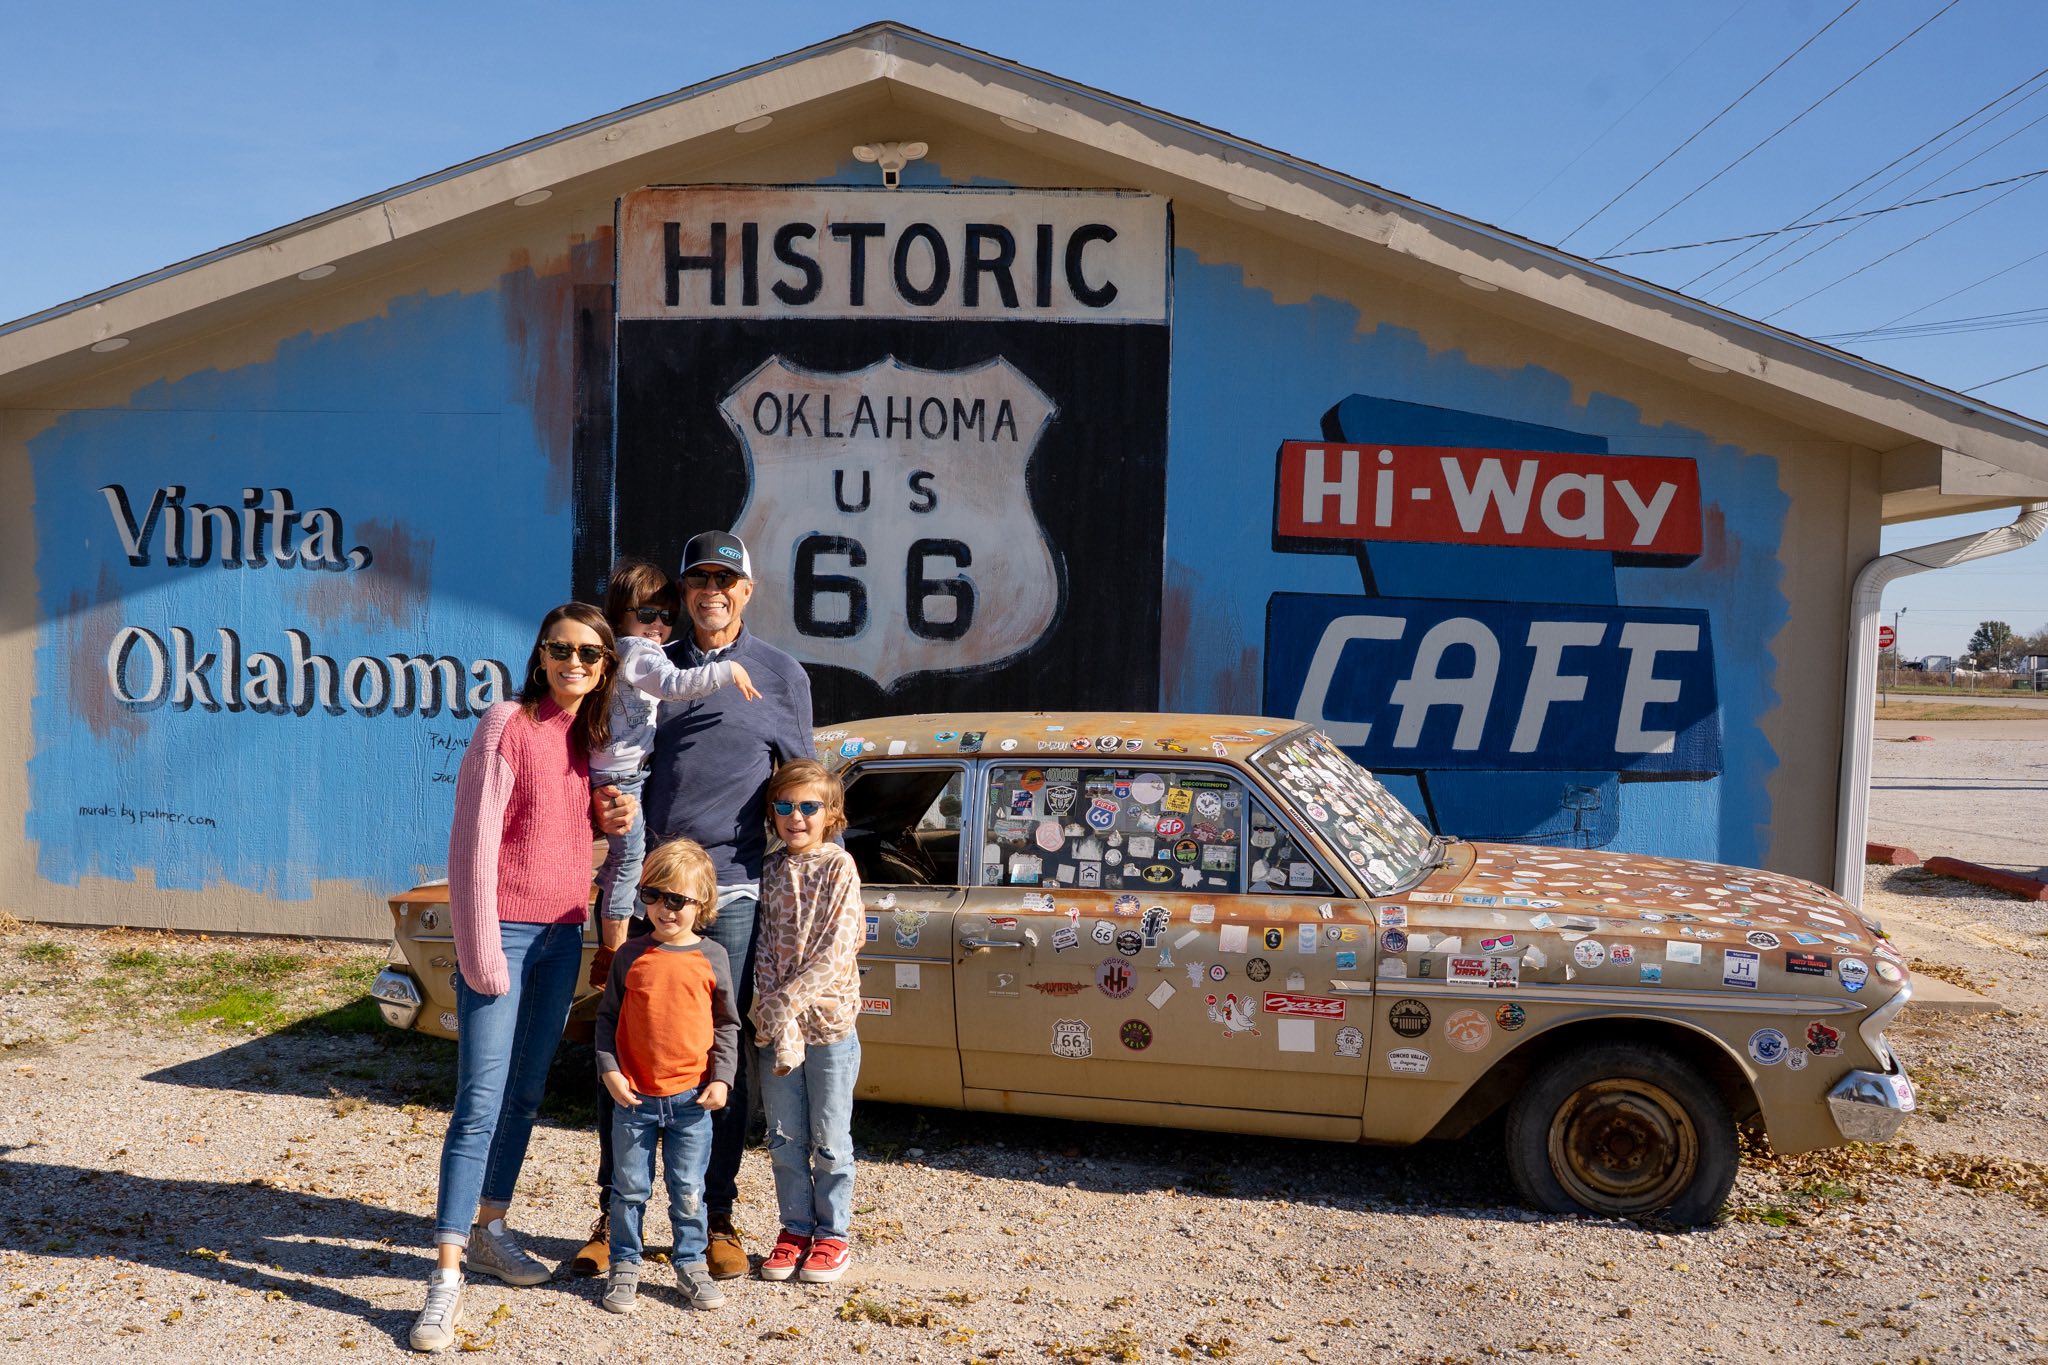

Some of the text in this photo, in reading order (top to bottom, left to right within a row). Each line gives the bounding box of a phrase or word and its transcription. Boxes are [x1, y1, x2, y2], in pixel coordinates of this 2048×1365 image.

[663, 221, 1119, 309] HISTORIC
[752, 391, 1019, 443] OKLAHOMA
[1302, 449, 1679, 546] Hi-Way
[98, 484, 373, 571] Vinita,
[793, 534, 976, 640] 66
[106, 626, 514, 719] Oklahoma
[1294, 615, 1700, 753] CAFE
[427, 730, 470, 750] PALME
[845, 743, 858, 752] 66
[1096, 800, 1115, 811] FIFTY
[79, 802, 216, 829] murals by palmer.com
[1091, 810, 1110, 824] 66
[1288, 808, 1314, 833] MORROW
[1159, 820, 1181, 833] STP
[1096, 929, 1111, 941] 66
[1119, 931, 1140, 940] SUPPORT
[1613, 949, 1630, 958] 66
[1102, 958, 1130, 968] HOOVER
[1452, 959, 1485, 968] QUICK
[1455, 968, 1489, 977] DRAW
[1097, 983, 1135, 999] MANEUVERS
[861, 999, 889, 1010] IVEN
[1266, 997, 1343, 1014] Ozark
[1062, 1034, 1082, 1047] 66
[1345, 1037, 1354, 1045] 66
[1073, 1046, 1091, 1057] HERE
[1410, 1053, 1429, 1061] VALLEY
